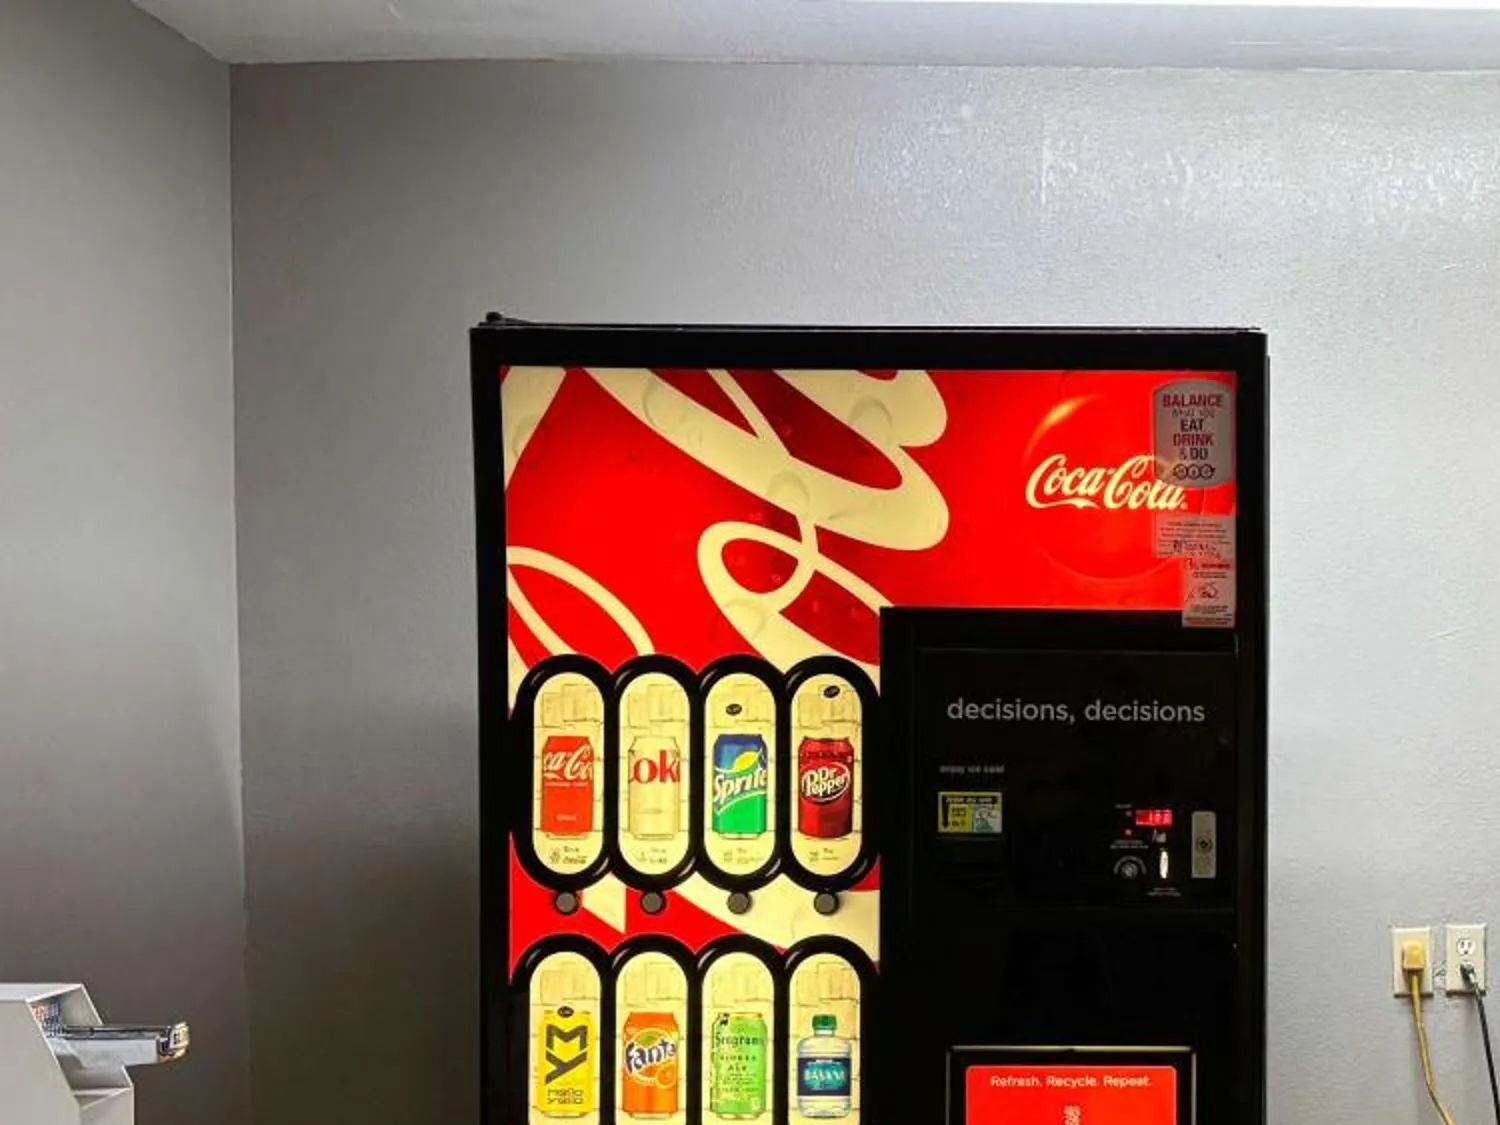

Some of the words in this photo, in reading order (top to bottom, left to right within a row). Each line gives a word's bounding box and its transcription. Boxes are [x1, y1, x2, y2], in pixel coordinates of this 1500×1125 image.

[1162, 393, 1224, 408] BALANCE
[1180, 419, 1204, 432] EAT
[1173, 433, 1214, 446] DRINK
[1190, 447, 1209, 460] DO
[947, 698, 1076, 725] decisions,
[1085, 700, 1206, 722] decisions
[818, 767, 838, 781] Dr
[713, 766, 768, 804] Sprite
[801, 770, 848, 797] Pepper
[990, 1075, 1042, 1088] Refresh.
